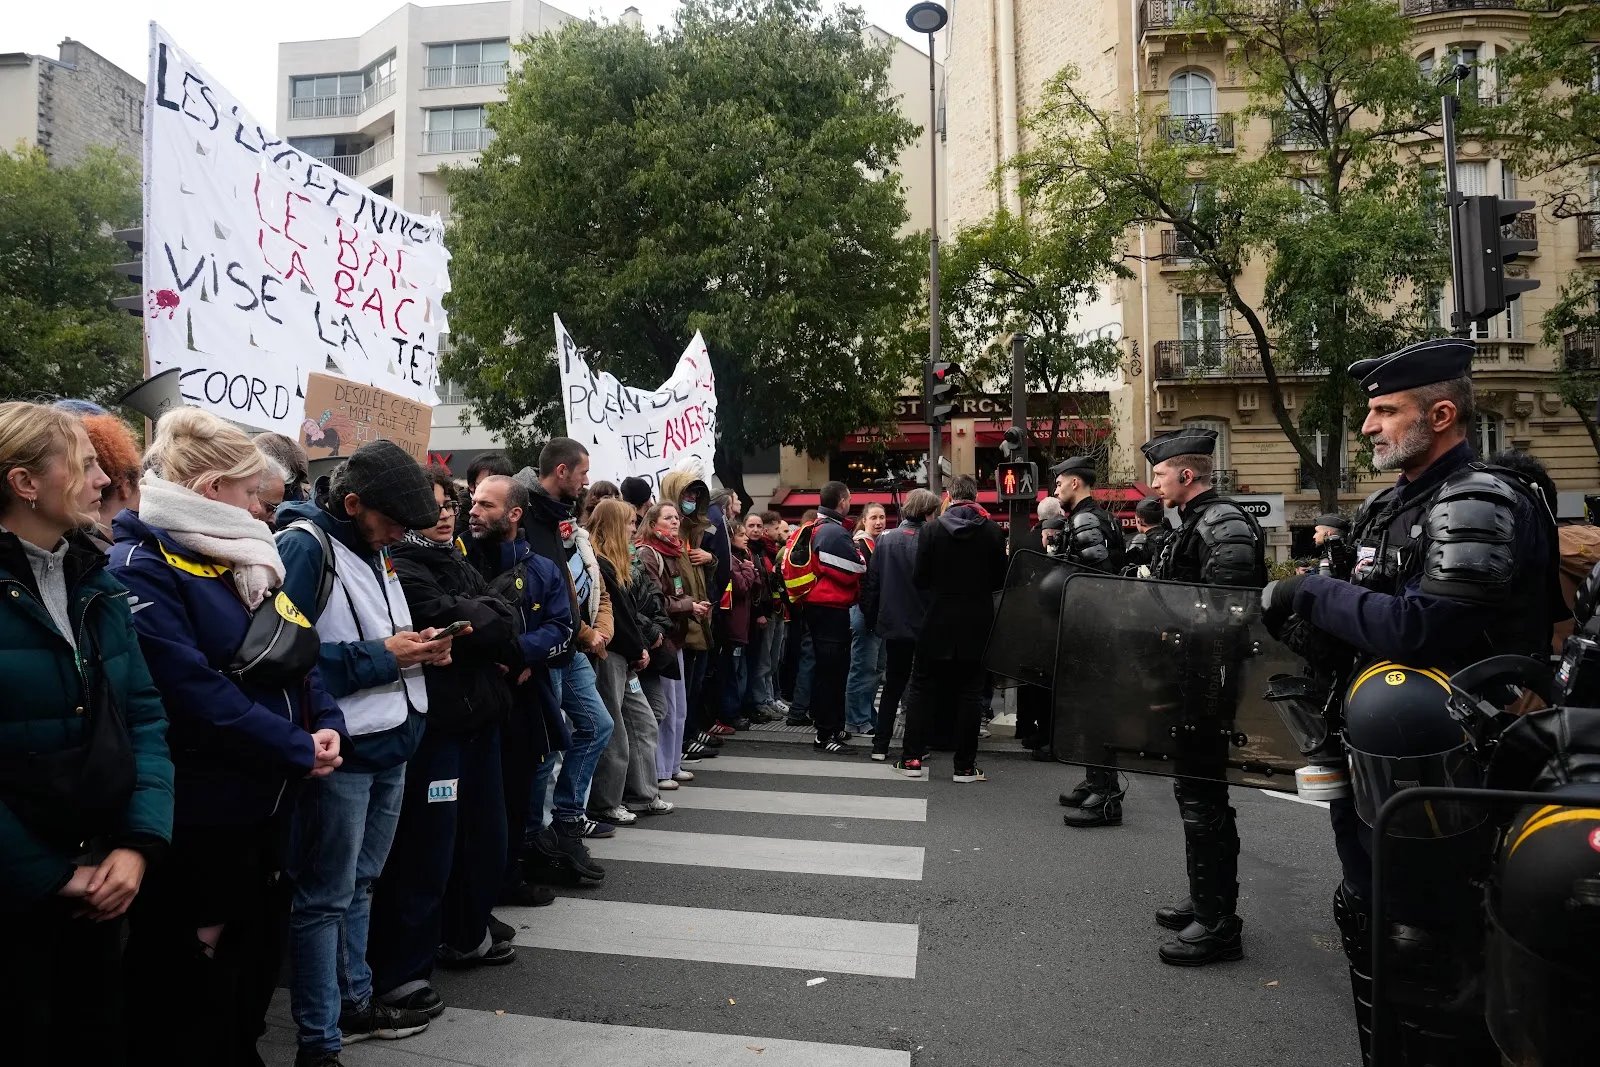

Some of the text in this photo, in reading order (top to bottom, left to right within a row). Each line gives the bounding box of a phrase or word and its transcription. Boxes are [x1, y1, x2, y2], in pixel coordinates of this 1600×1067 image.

[258, 228, 415, 336] LA BAC
[314, 301, 370, 361] LA
[349, 405, 372, 423] MOI
[377, 412, 398, 431] QUI
